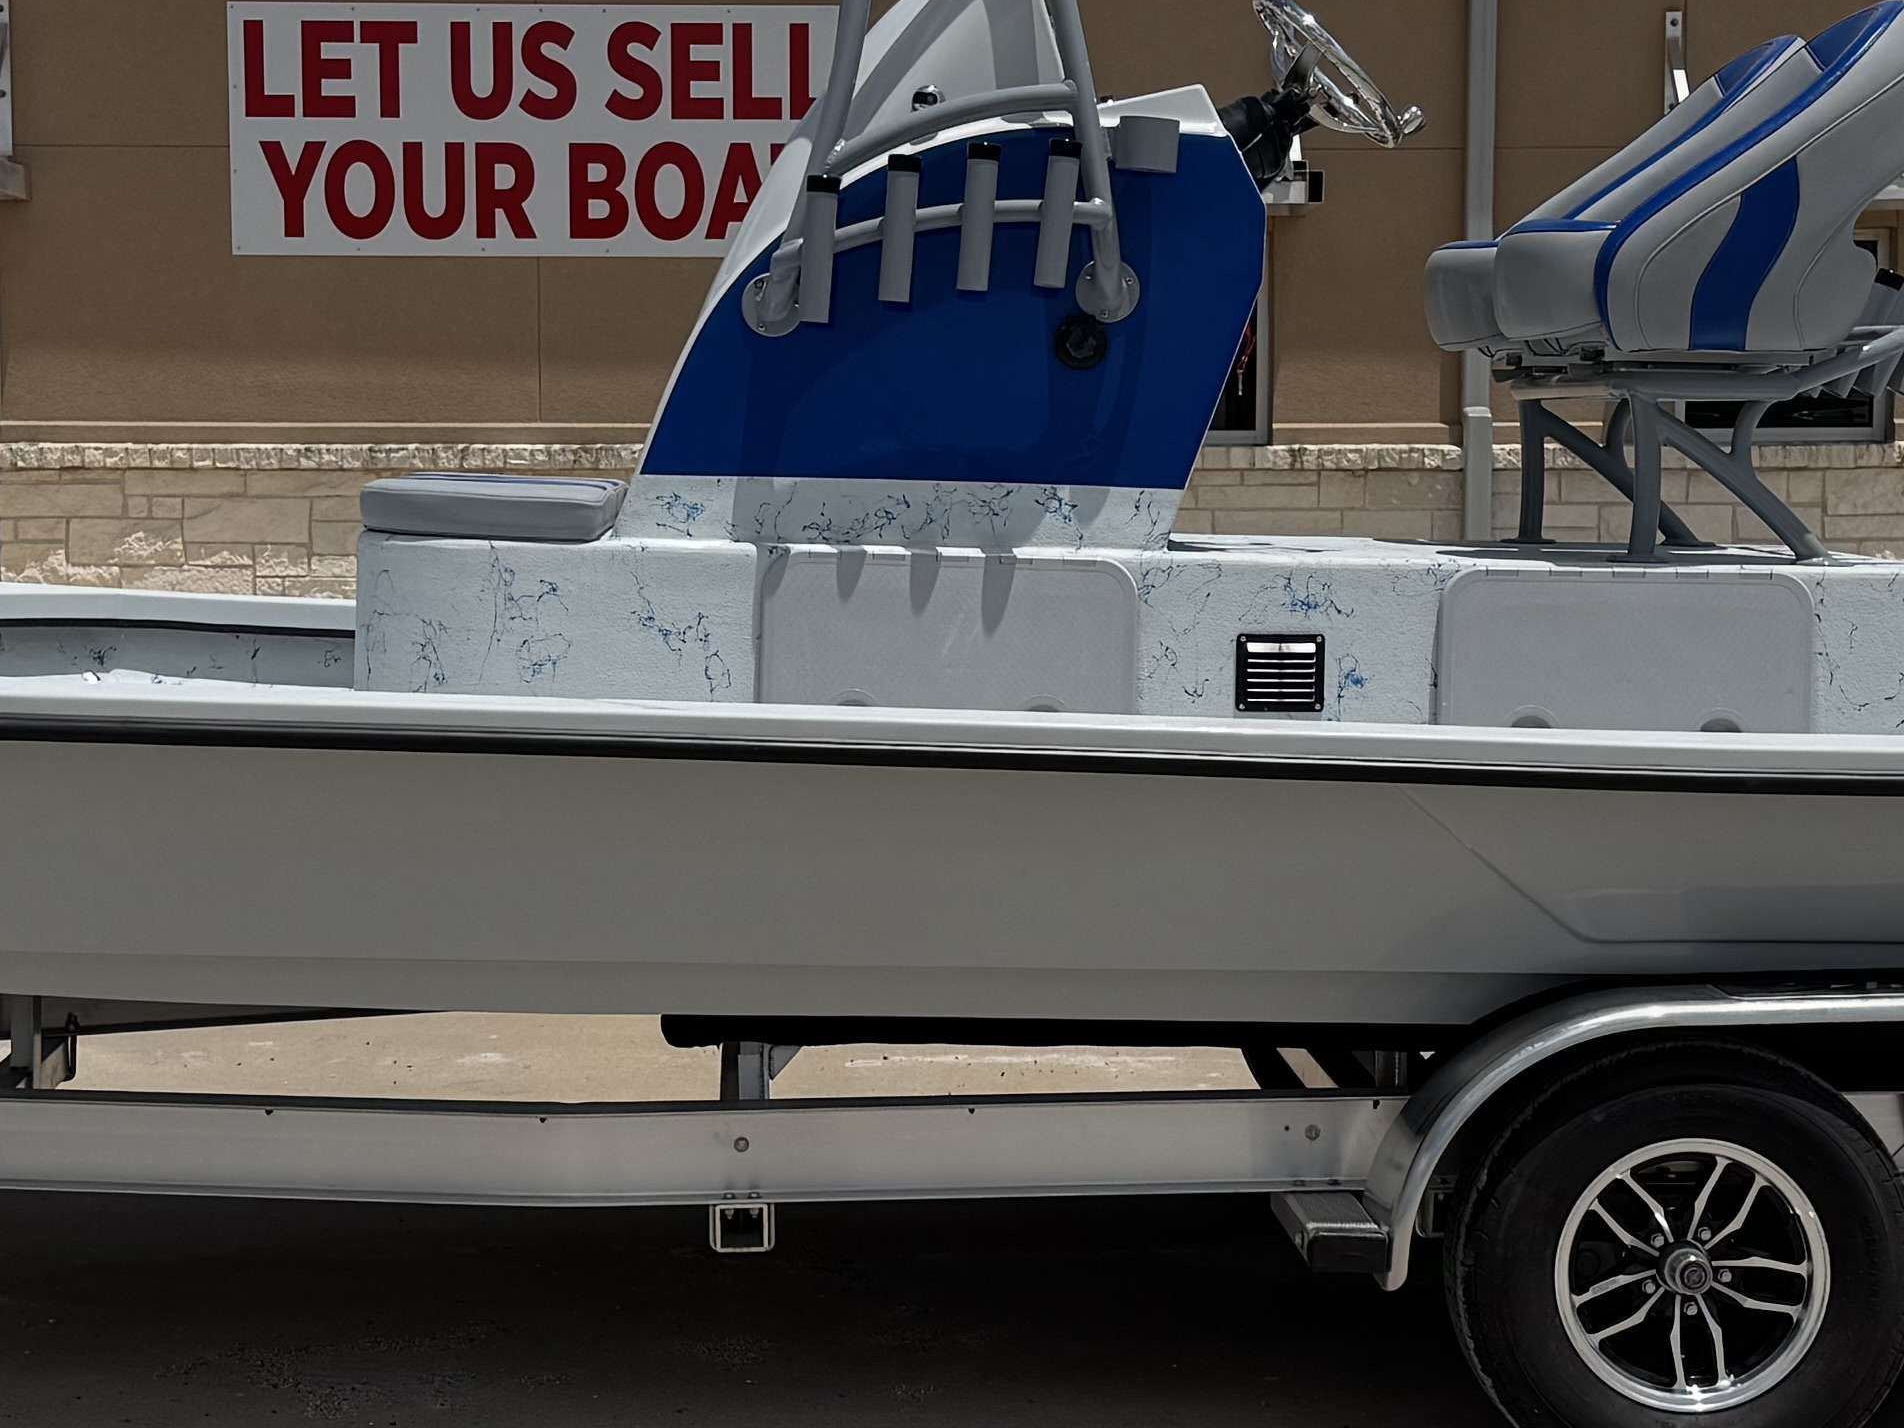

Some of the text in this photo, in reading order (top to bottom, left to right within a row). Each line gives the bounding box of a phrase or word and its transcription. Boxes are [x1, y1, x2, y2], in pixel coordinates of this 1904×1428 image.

[242, 19, 818, 121] LET US SELL
[258, 139, 789, 241] YOUR BOA
